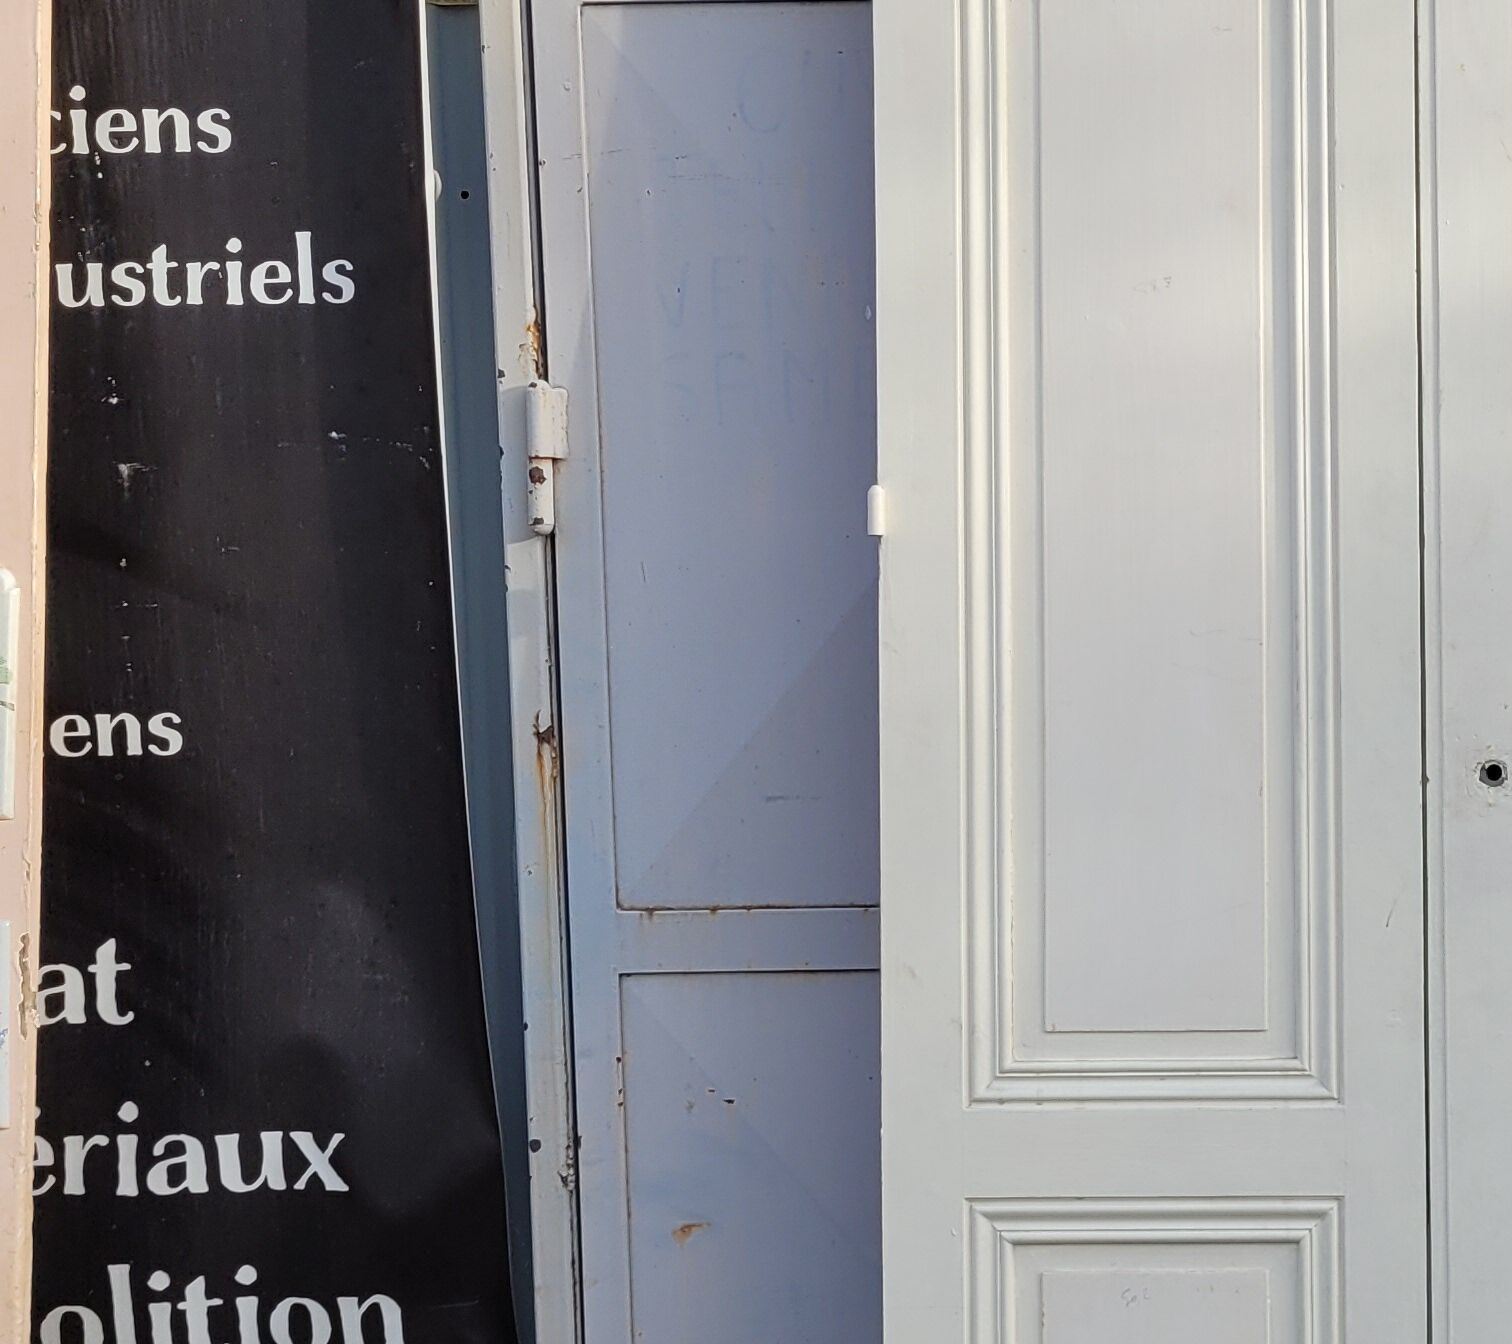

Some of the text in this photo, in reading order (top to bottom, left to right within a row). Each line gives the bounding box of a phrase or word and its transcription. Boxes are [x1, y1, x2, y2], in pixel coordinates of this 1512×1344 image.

[54, 230, 355, 308] ustriels
[49, 712, 183, 758] ens
[37, 938, 135, 1026] at
